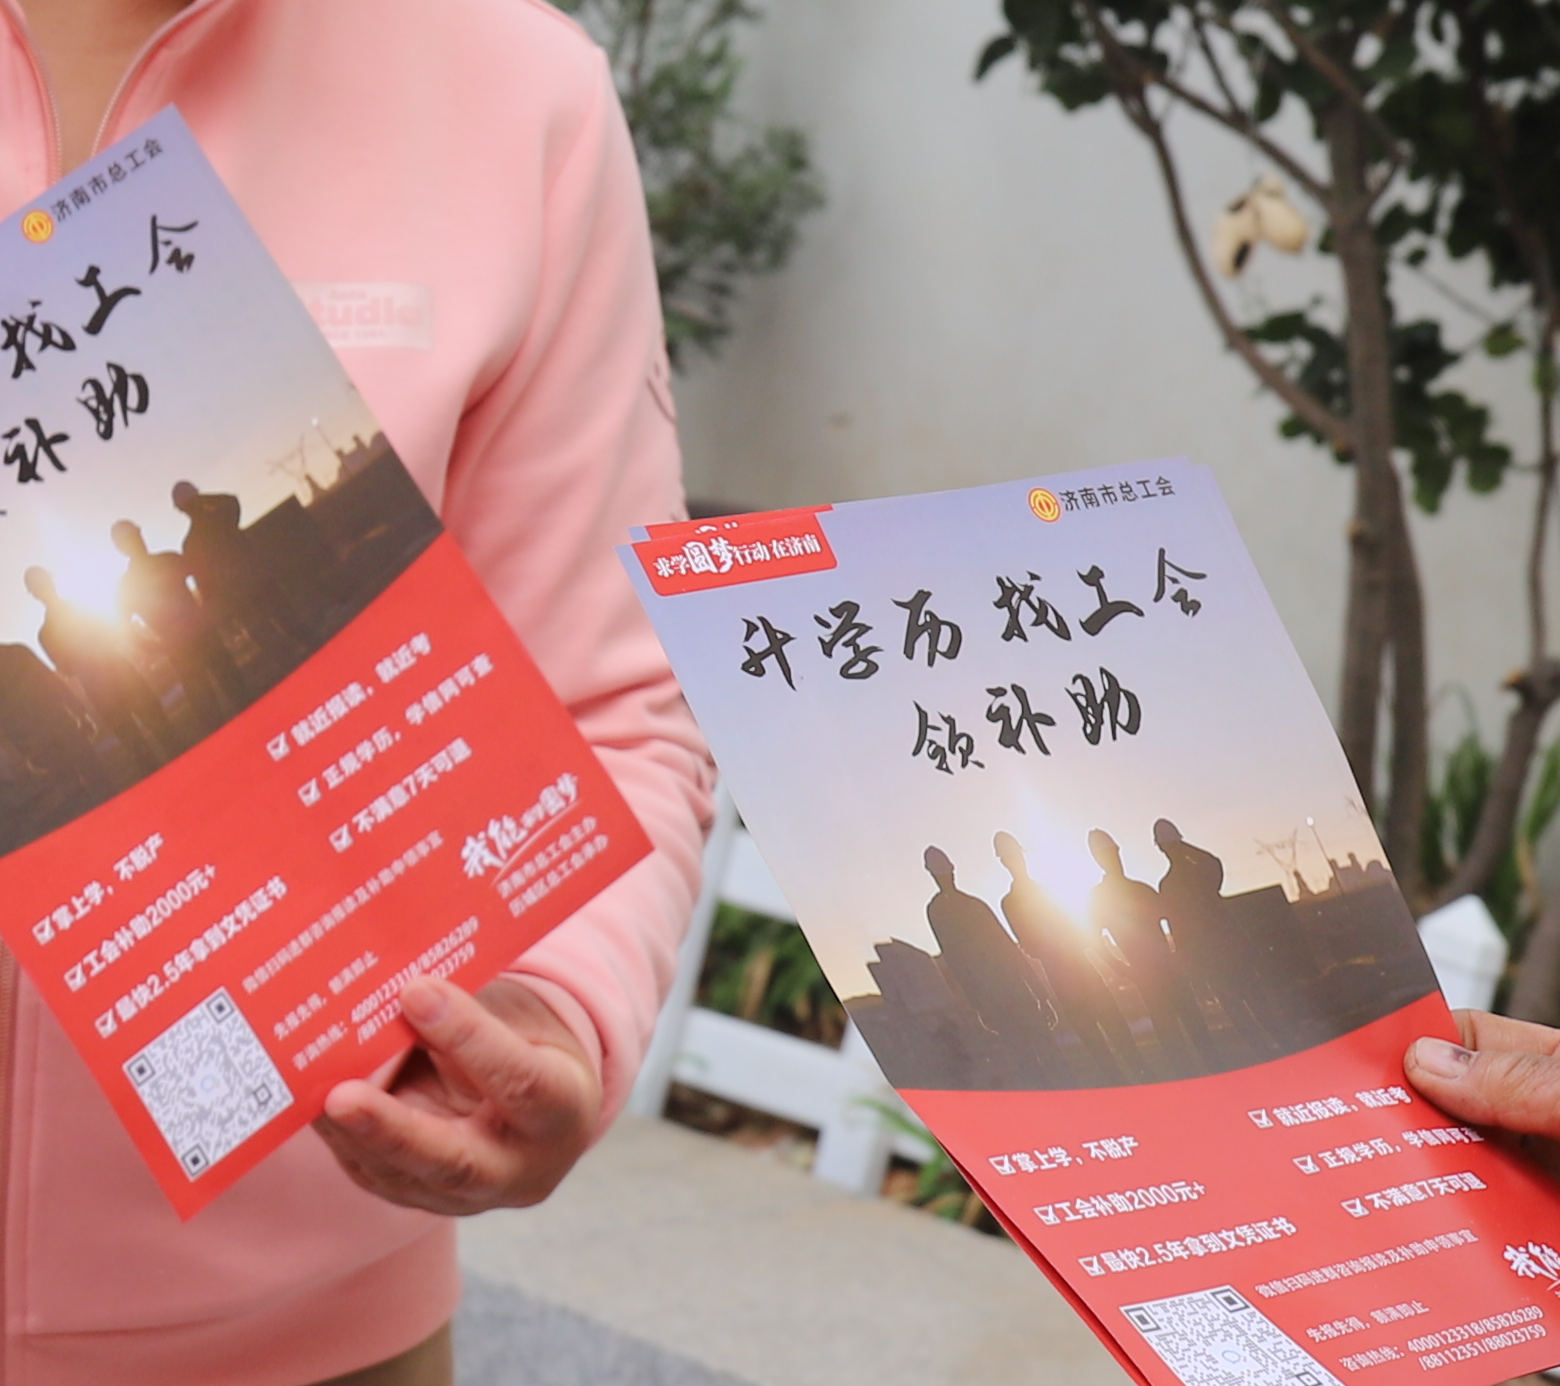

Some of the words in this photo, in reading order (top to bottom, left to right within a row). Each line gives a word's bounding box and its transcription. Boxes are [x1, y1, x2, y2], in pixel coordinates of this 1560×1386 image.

[51, 137, 163, 223] 济南市总工会
[1061, 475, 1177, 513] 济南市总工会
[913, 667, 1141, 775] 领补助
[1055, 1180, 1207, 1223] 工会补助2000元+
[1364, 1171, 1488, 1211] 不满意7天可退
[1100, 1215, 1298, 1274] 最快2.5年拿到文凭证书
